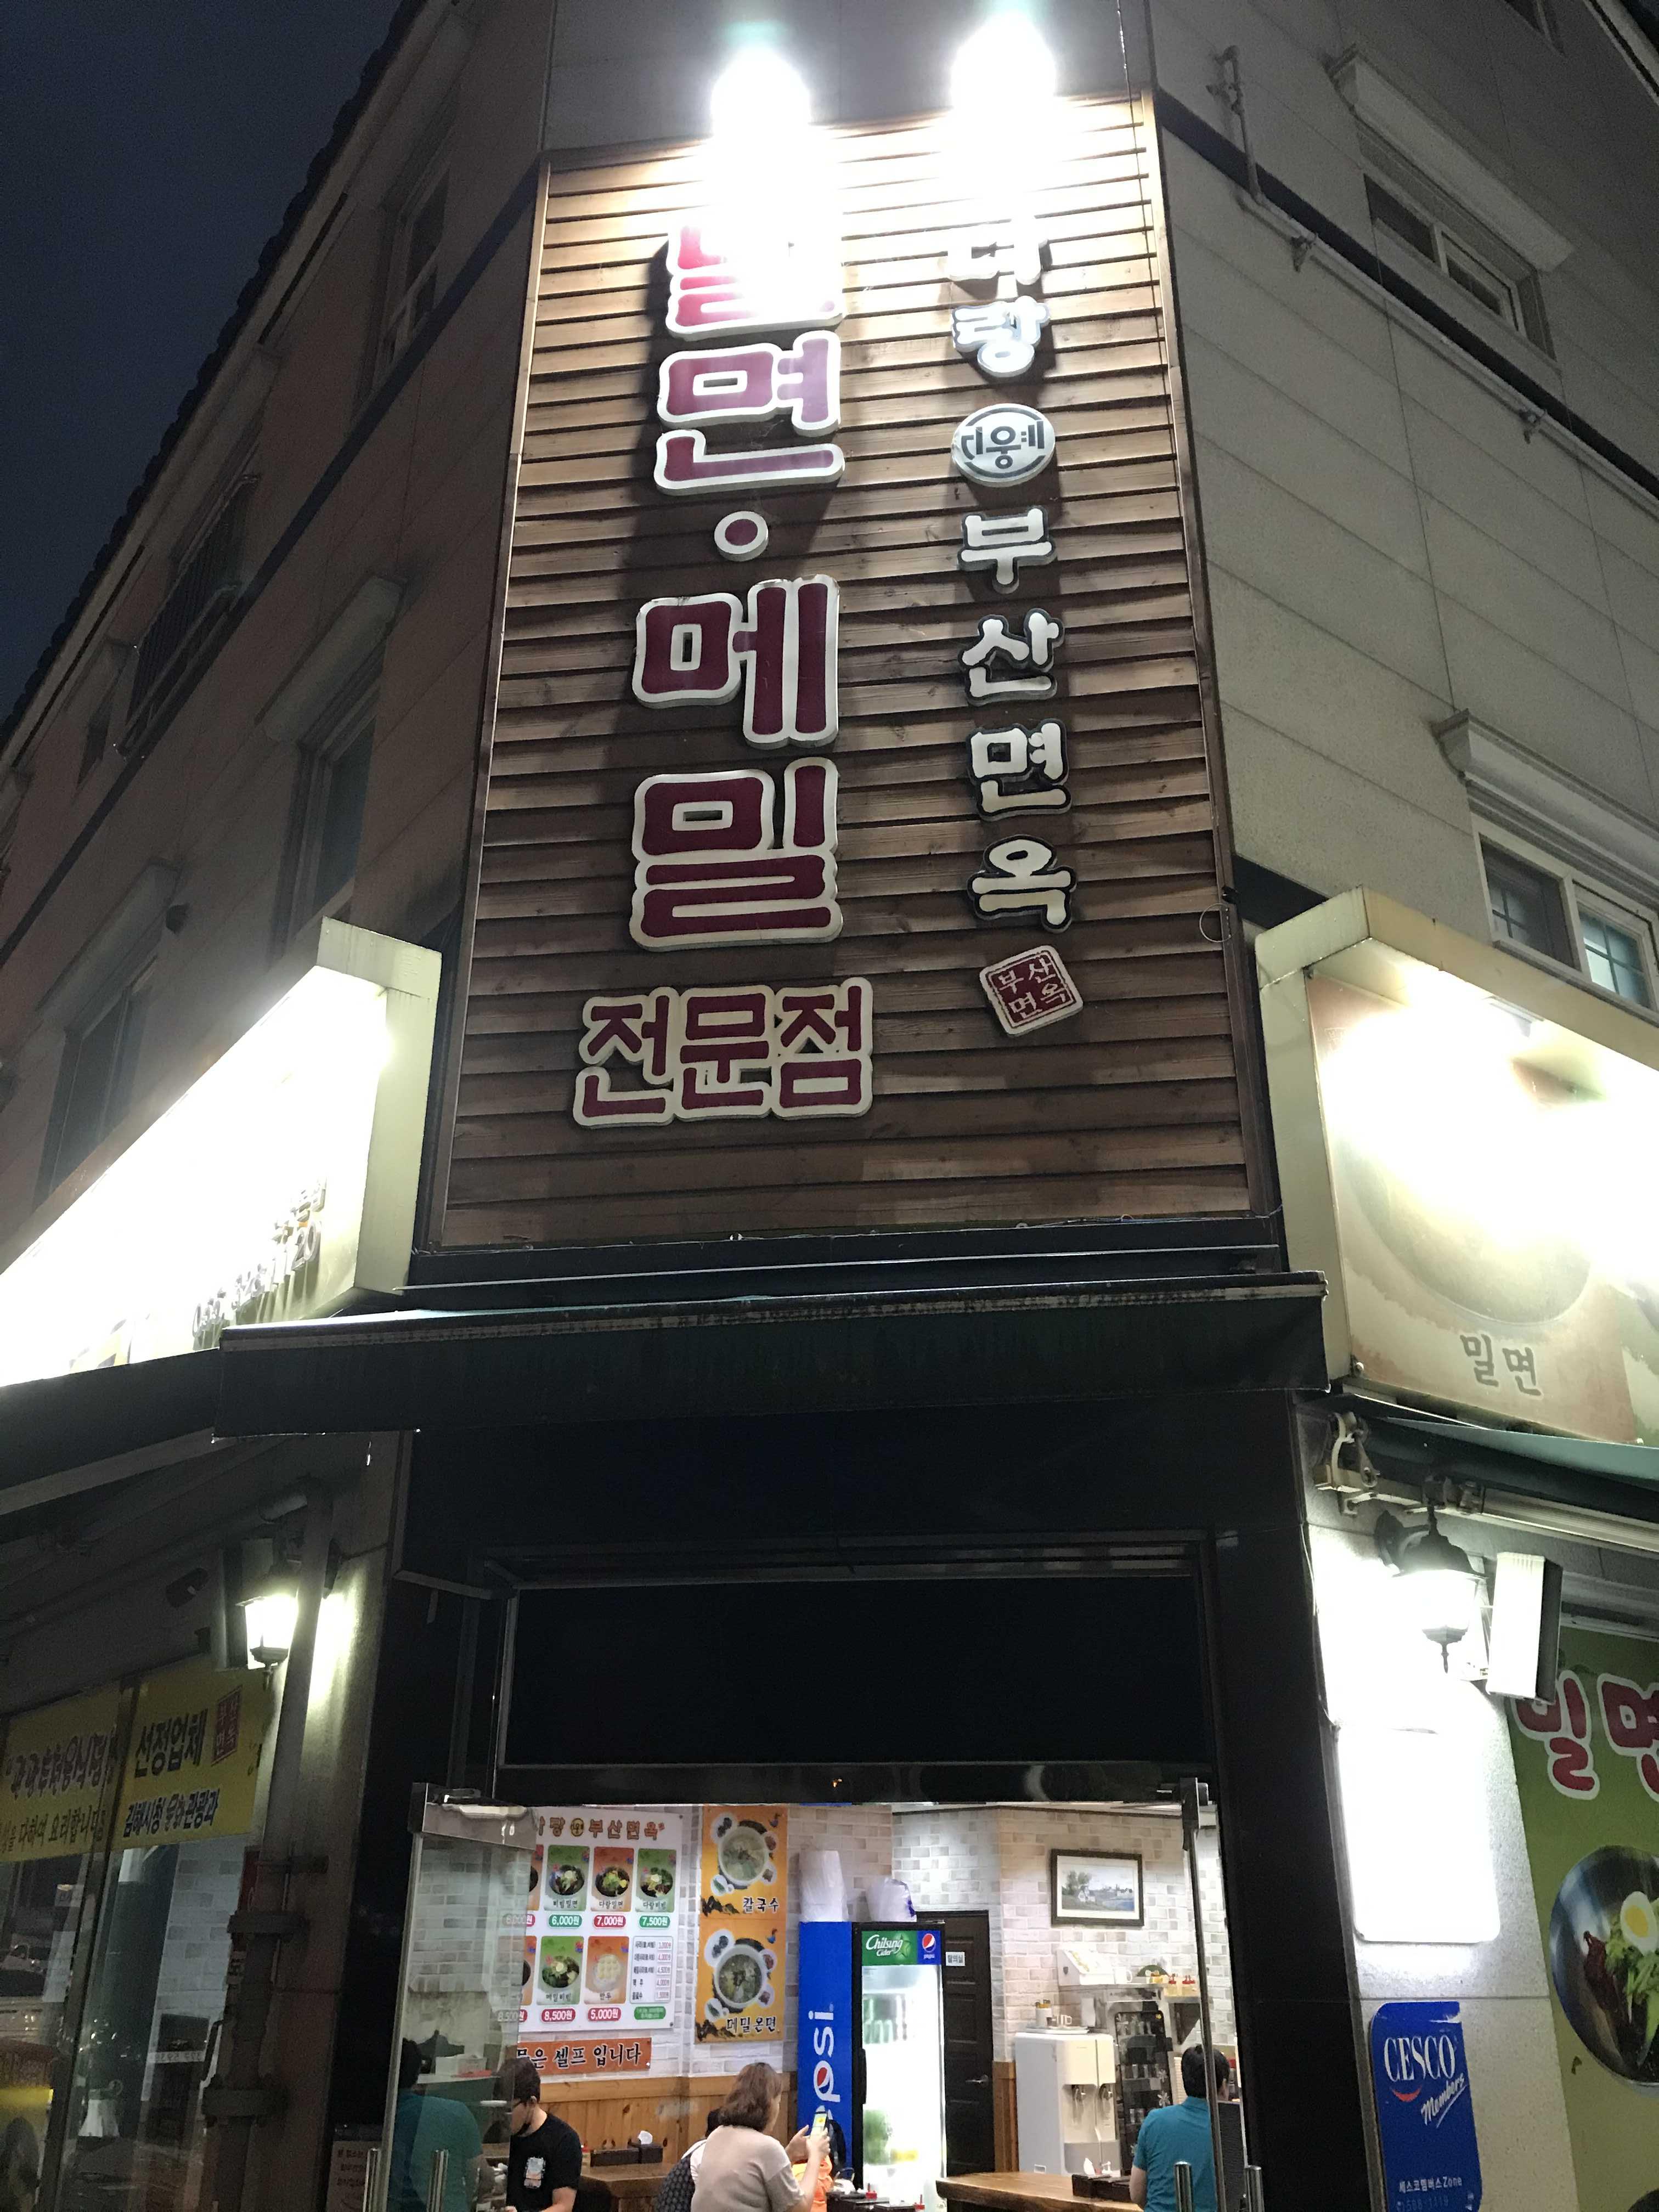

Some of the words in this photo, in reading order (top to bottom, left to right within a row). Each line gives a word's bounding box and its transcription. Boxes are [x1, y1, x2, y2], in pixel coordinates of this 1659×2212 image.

[997, 957, 1057, 994] 부산
[1007, 983, 1068, 1019] 면옥
[573, 977, 873, 1128] 전문점
[1459, 1334, 1543, 1397] 밀면
[588, 1819, 658, 1841] 부산면옥
[742, 1896, 780, 1913] 칼국수
[551, 1916, 580, 1926] 6,000원
[596, 1916, 624, 1926] 7,000원
[642, 1916, 668, 1926] 7,500원
[866, 1934, 904, 1954] Chilsung
[544, 2010, 573, 2021] 8,500원
[590, 2010, 619, 2020] 5,000원
[554, 2046, 586, 2068] 셀프
[593, 2043, 641, 2067] 입니다
[1384, 2034, 1456, 2082] CESCO
[1420, 2072, 1465, 2126] Members
